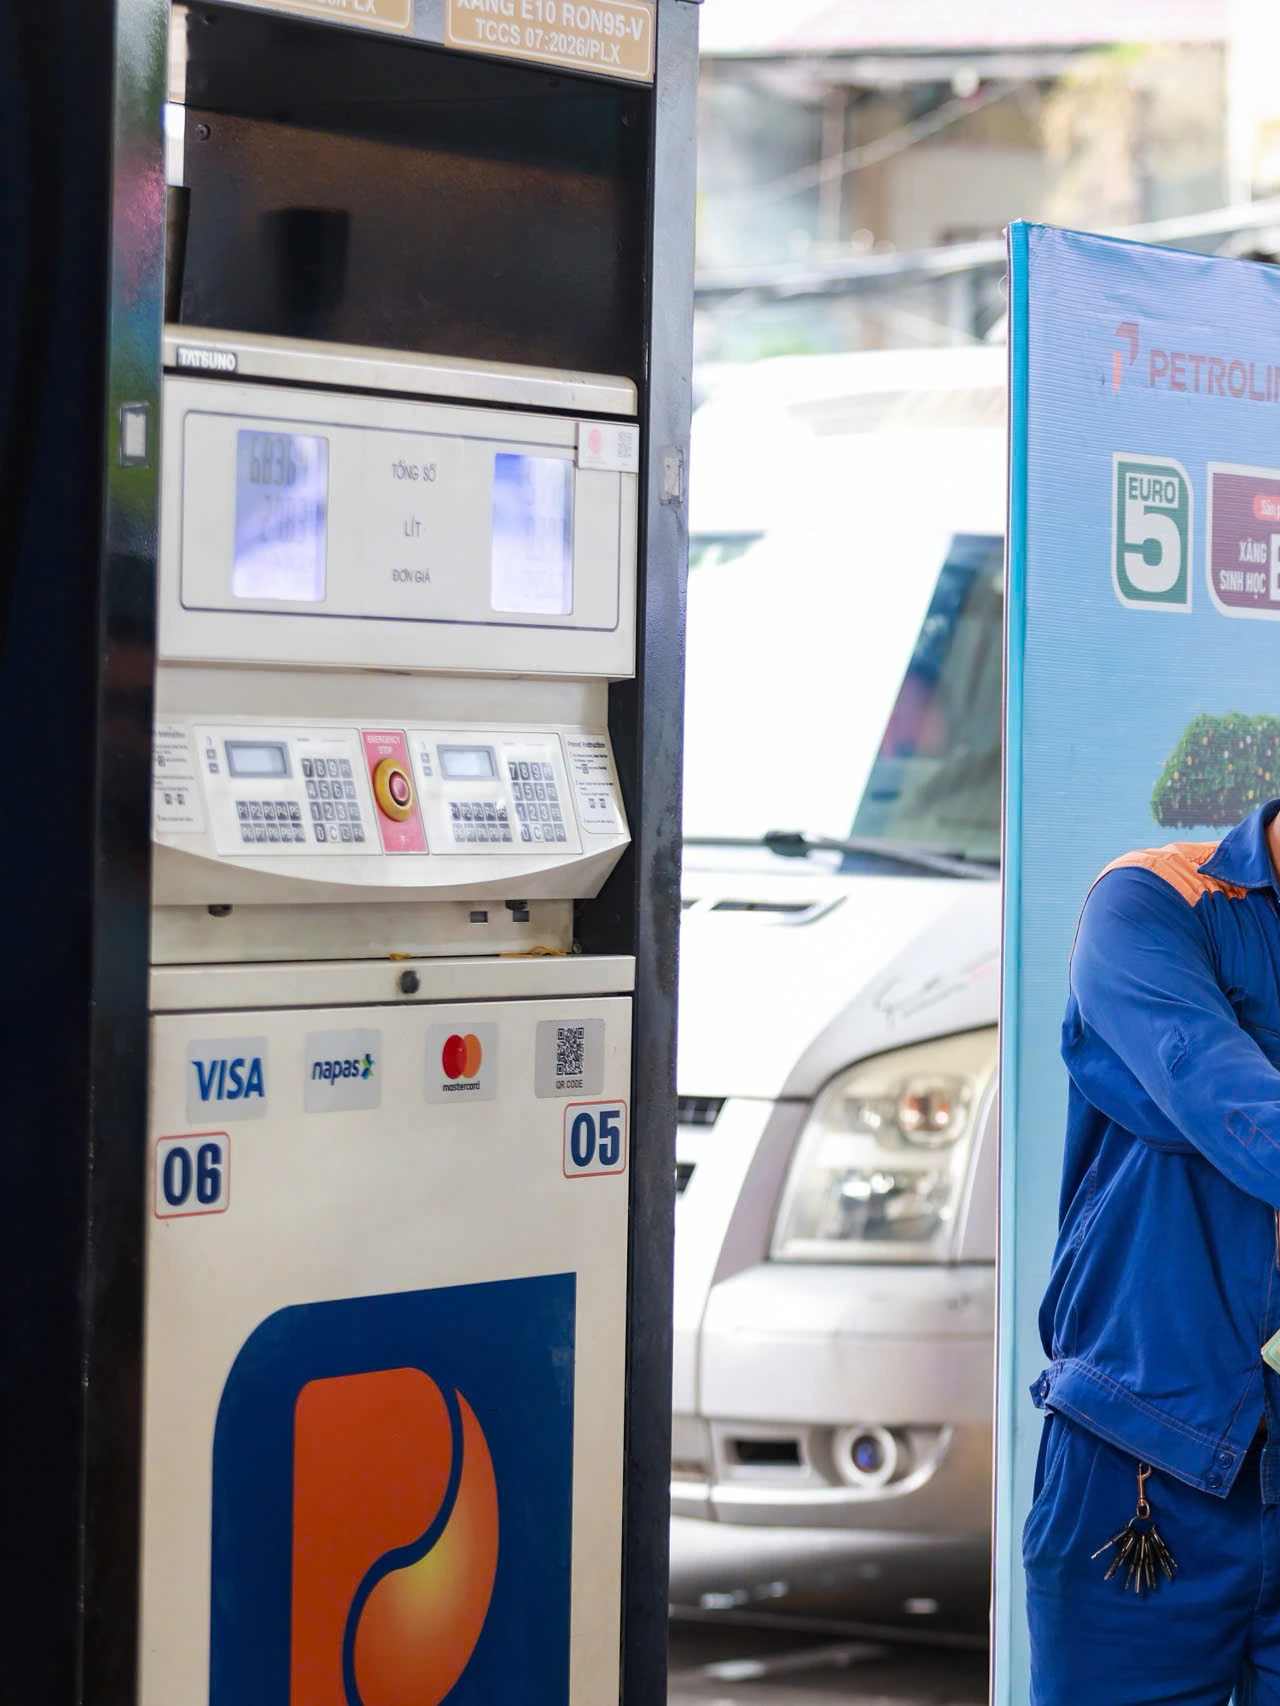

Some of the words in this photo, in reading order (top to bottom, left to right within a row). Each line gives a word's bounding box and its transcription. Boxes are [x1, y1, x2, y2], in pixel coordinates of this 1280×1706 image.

[521, 0, 556, 24] E10
[562, 5, 644, 40] RON95-V
[475, 18, 520, 45] TCCS
[526, 30, 621, 64] 07:2026/PLX
[180, 347, 236, 371] TATSUNO
[1128, 477, 1176, 501] EURO
[405, 514, 421, 537] LÍT
[1124, 503, 1181, 592] 5
[1239, 538, 1267, 563] XĂNG
[1220, 569, 1243, 592] SINH
[1245, 572, 1266, 600] HỌC
[192, 1057, 265, 1101] VISA
[311, 1058, 361, 1086] napas
[442, 1081, 481, 1092] mastercard
[556, 1080, 565, 1089] QR
[566, 1079, 583, 1088] CODE
[570, 1110, 621, 1167] 05
[163, 1143, 222, 1206] 06
